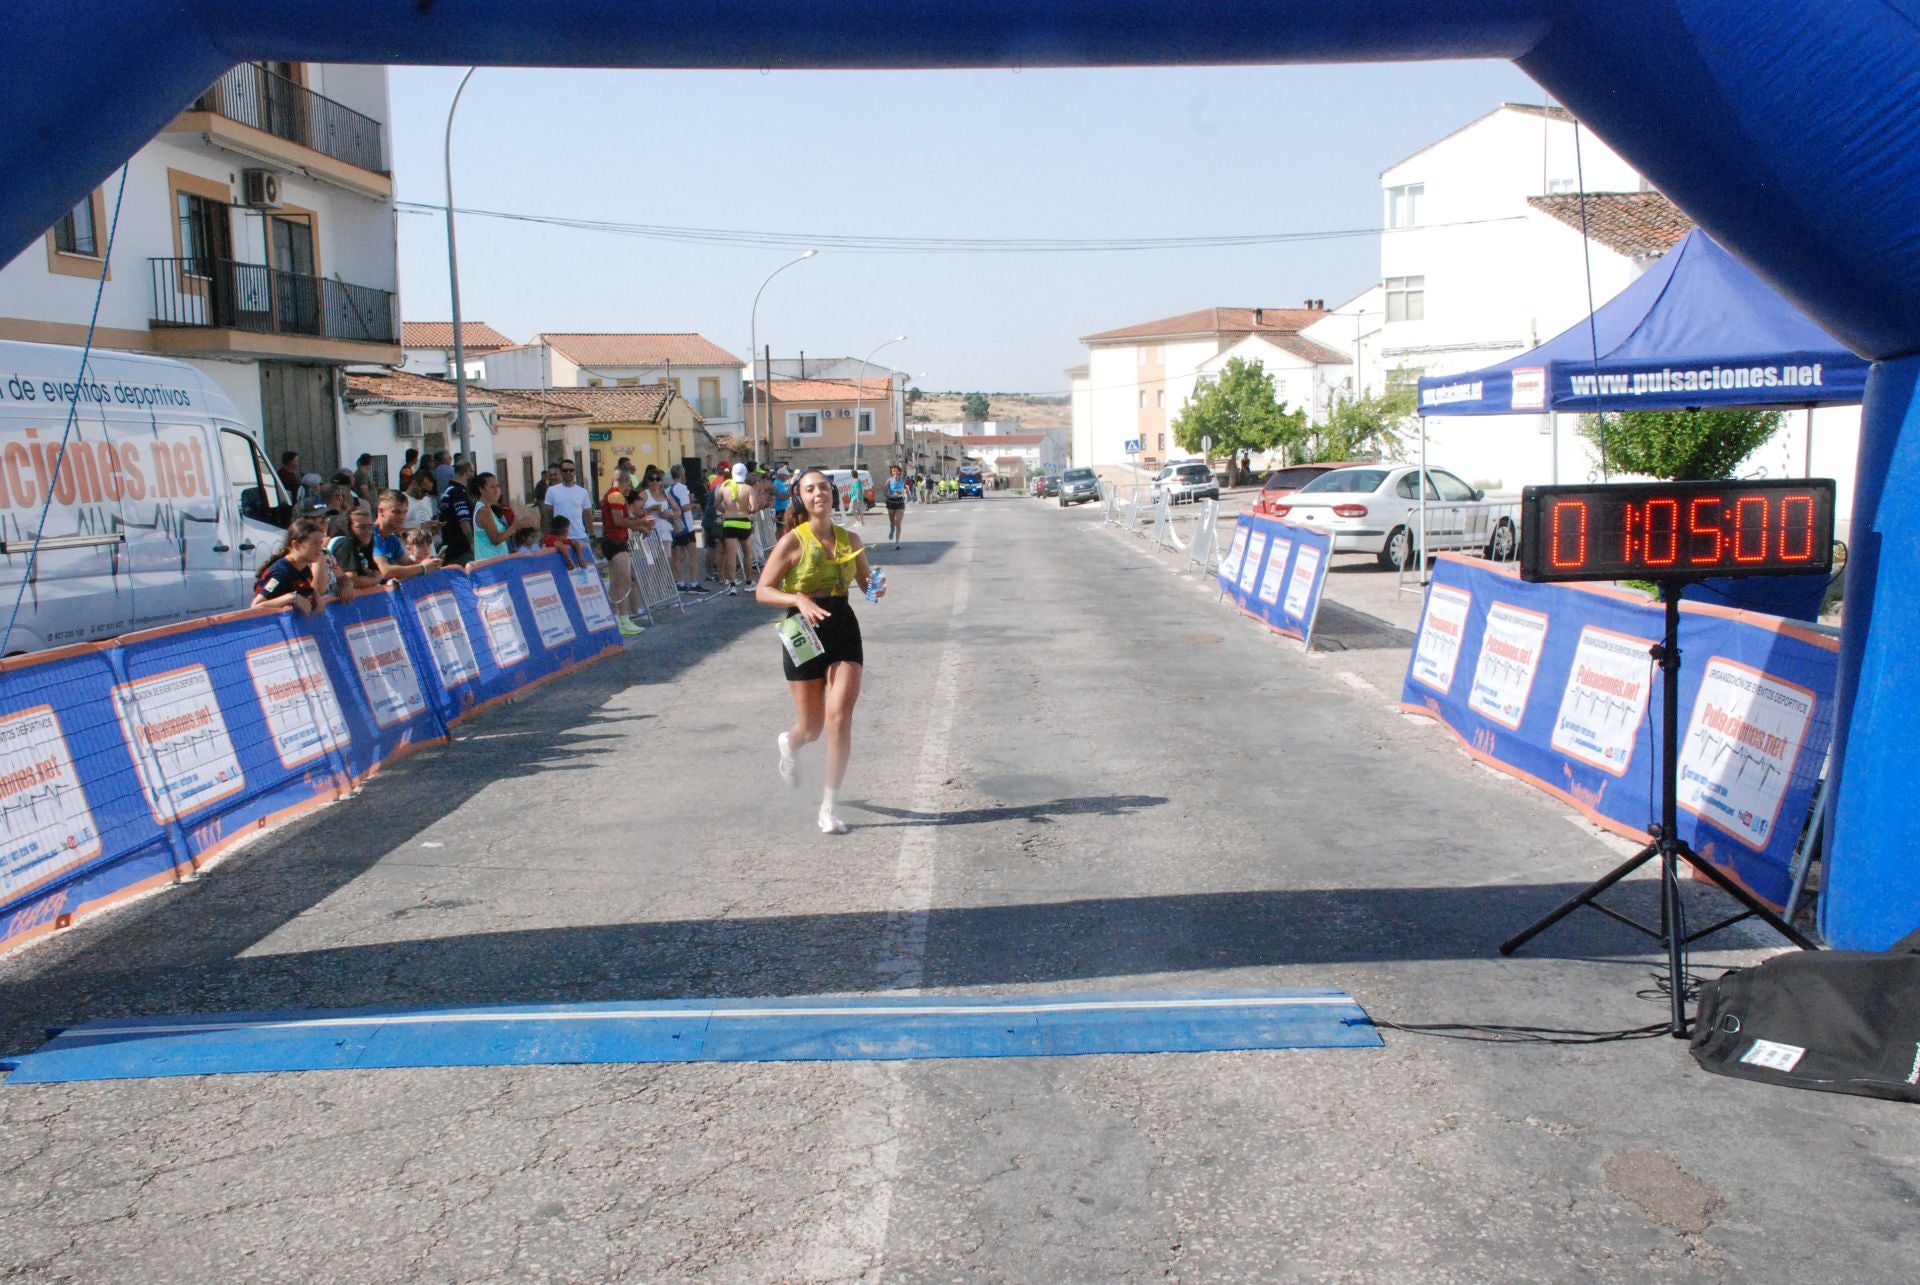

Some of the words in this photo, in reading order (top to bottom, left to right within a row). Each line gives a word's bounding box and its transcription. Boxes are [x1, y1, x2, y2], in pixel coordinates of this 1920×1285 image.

[9, 373, 36, 401] de
[43, 378, 111, 403] eventos
[114, 381, 191, 409] deportivos
[1570, 363, 1822, 396] www.pulsaciones.net
[790, 630, 807, 648] 16
[1702, 703, 1789, 761] Pulsaciones.net
[0, 754, 62, 800] ones.net
